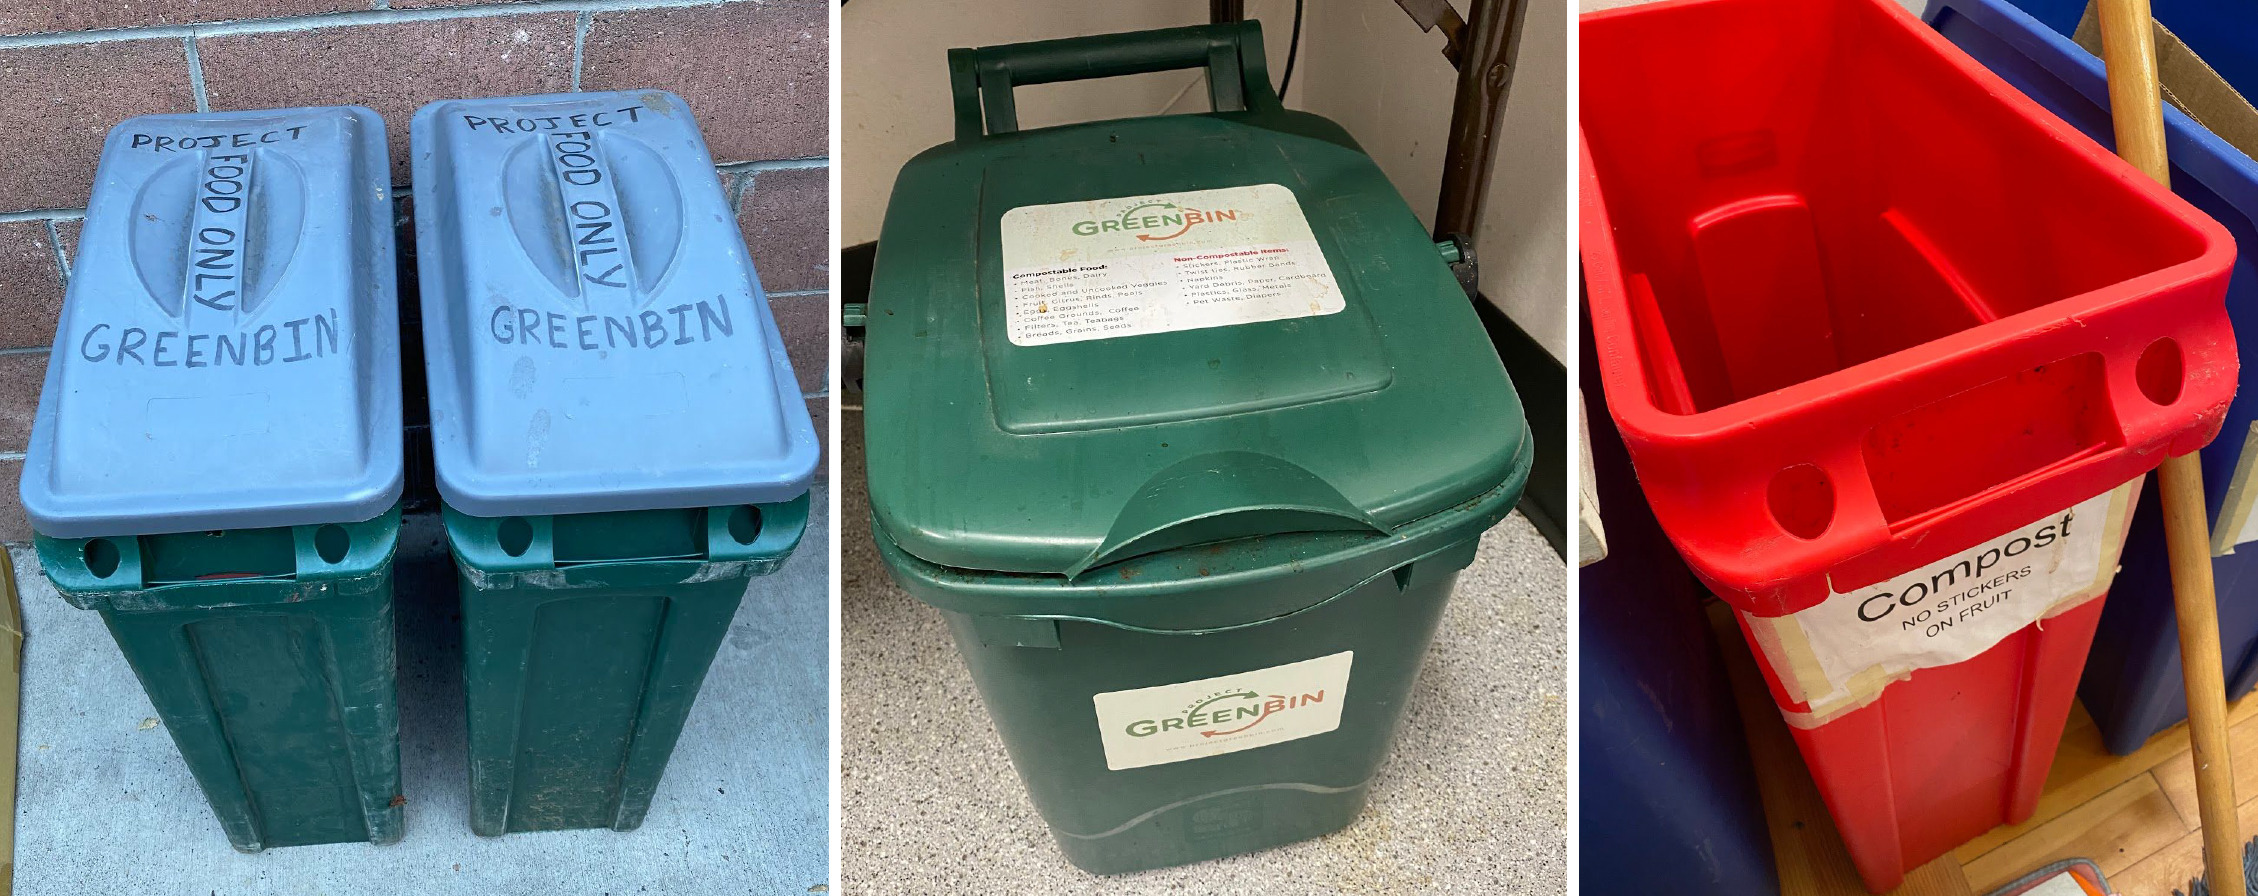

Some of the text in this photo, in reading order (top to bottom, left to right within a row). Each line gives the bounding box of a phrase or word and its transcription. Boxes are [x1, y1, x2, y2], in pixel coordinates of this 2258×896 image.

[131, 125, 310, 153] PROJECT
[465, 105, 644, 135] PROJECT
[193, 153, 249, 312] FOOD ONLY
[553, 130, 627, 290] FOOD ONLY
[1072, 208, 1237, 236] GREENBIN
[1012, 264, 1108, 280] Compostable Food:
[1173, 247, 1290, 263] Non-Compostable Items:
[81, 308, 340, 368] GREENBIN
[490, 294, 735, 351] GREENBIN
[1085, 316, 1124, 326] Teabags
[1857, 512, 2074, 623] Compost
[1902, 565, 2032, 631] NO STICKERS
[1925, 589, 2013, 638] ON FRUIT
[1125, 689, 1325, 738] GREENBIN
[1181, 687, 1243, 714] PROJECT
